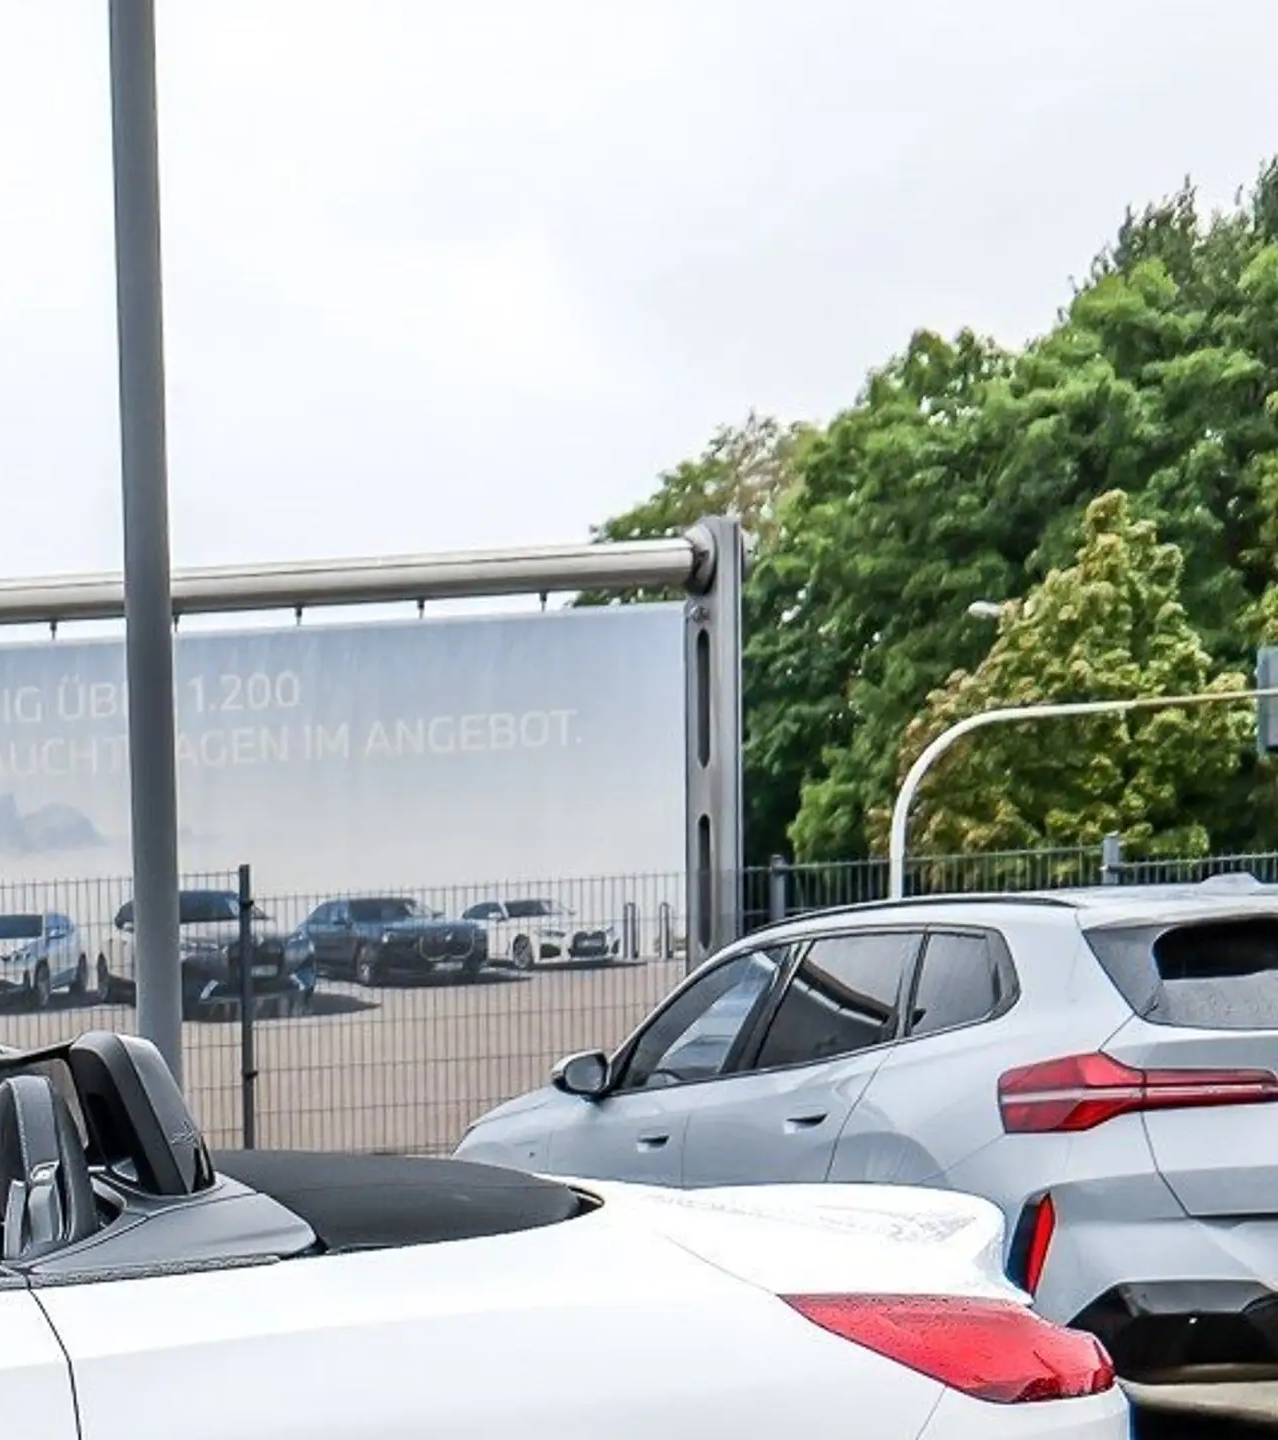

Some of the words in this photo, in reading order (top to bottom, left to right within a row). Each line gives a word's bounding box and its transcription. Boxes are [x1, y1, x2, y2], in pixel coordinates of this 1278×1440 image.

[57, 674, 127, 721] ÜB
[186, 670, 301, 713] 1.200
[303, 722, 350, 762] IM
[364, 708, 583, 759] ANGEBOT.
